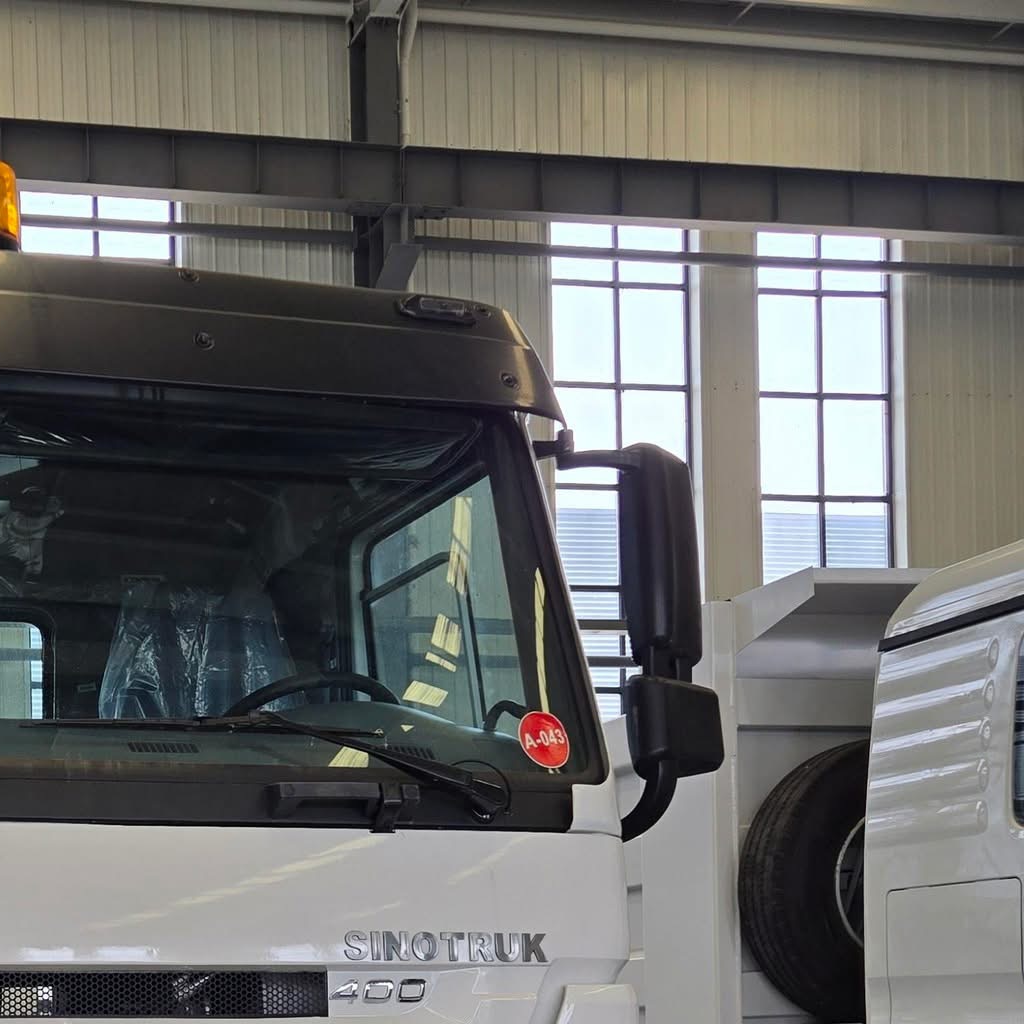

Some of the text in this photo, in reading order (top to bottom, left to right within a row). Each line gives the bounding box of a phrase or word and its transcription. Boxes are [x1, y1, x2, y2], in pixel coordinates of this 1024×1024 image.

[525, 728, 565, 749] A-043
[343, 930, 548, 963] SINOTRUK
[329, 978, 426, 1003] 400
